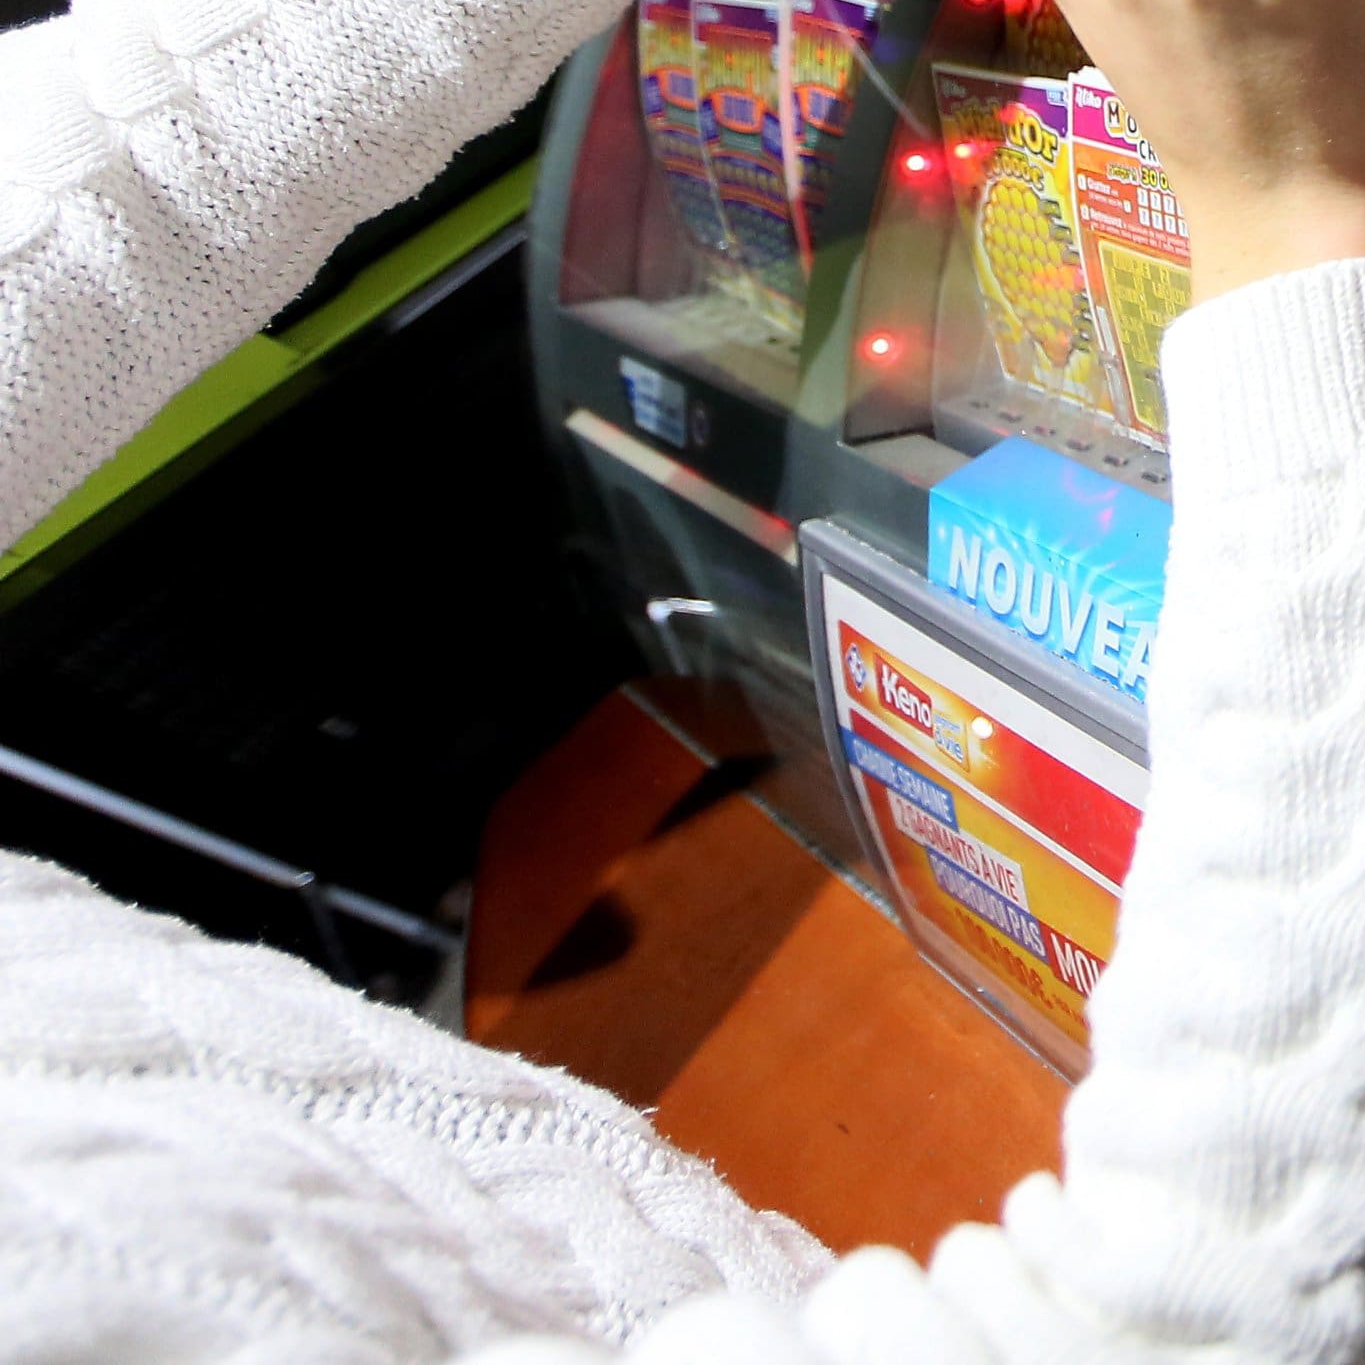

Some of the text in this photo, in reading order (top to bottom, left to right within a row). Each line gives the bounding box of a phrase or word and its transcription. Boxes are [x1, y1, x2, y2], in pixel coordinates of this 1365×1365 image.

[880, 662, 933, 730] Keno
[897, 764, 954, 824] SEMAINE
[907, 803, 980, 878] GAGNANTS
[992, 857, 1019, 903] VIE
[1005, 903, 1047, 959] PAS
